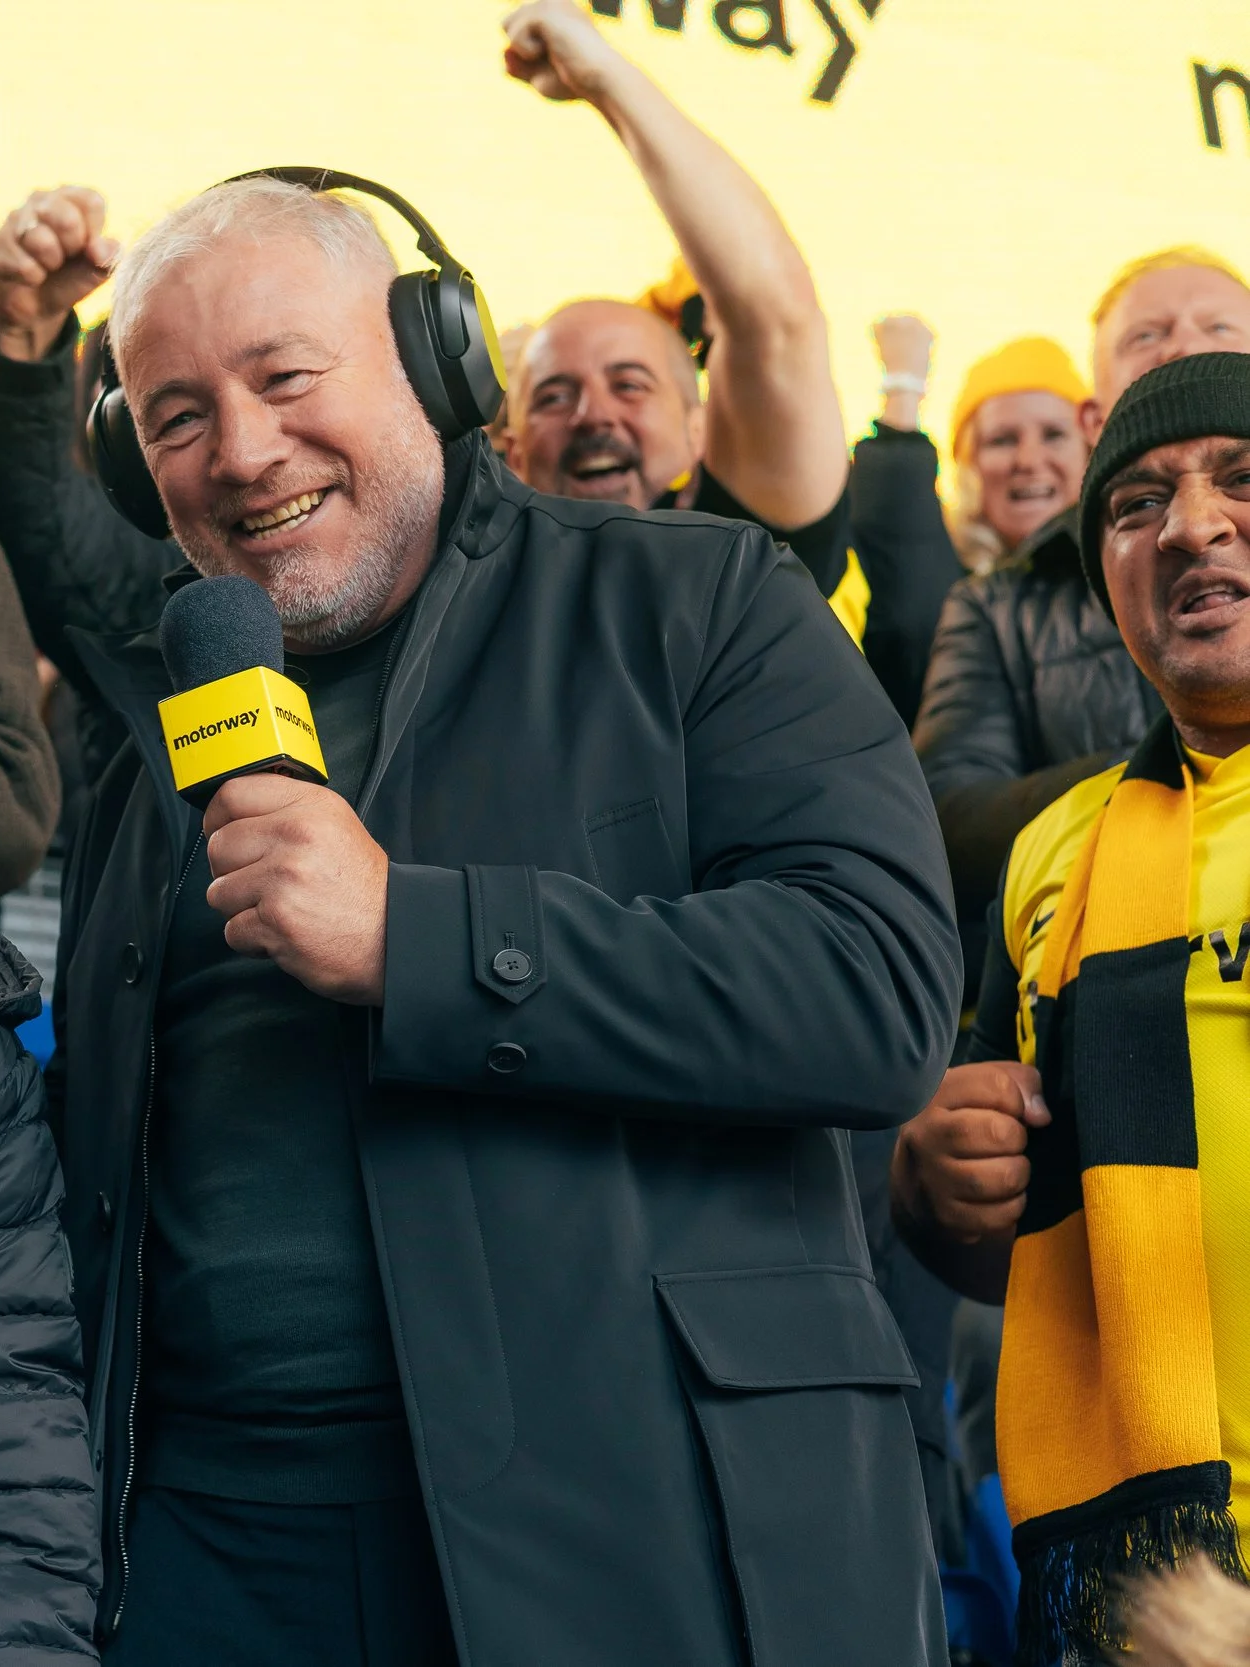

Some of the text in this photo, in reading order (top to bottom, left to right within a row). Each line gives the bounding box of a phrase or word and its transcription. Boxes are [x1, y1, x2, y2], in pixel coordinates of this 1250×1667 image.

[592, 0, 881, 103] ay
[173, 708, 260, 750] motorway
[275, 706, 315, 741] motorway
